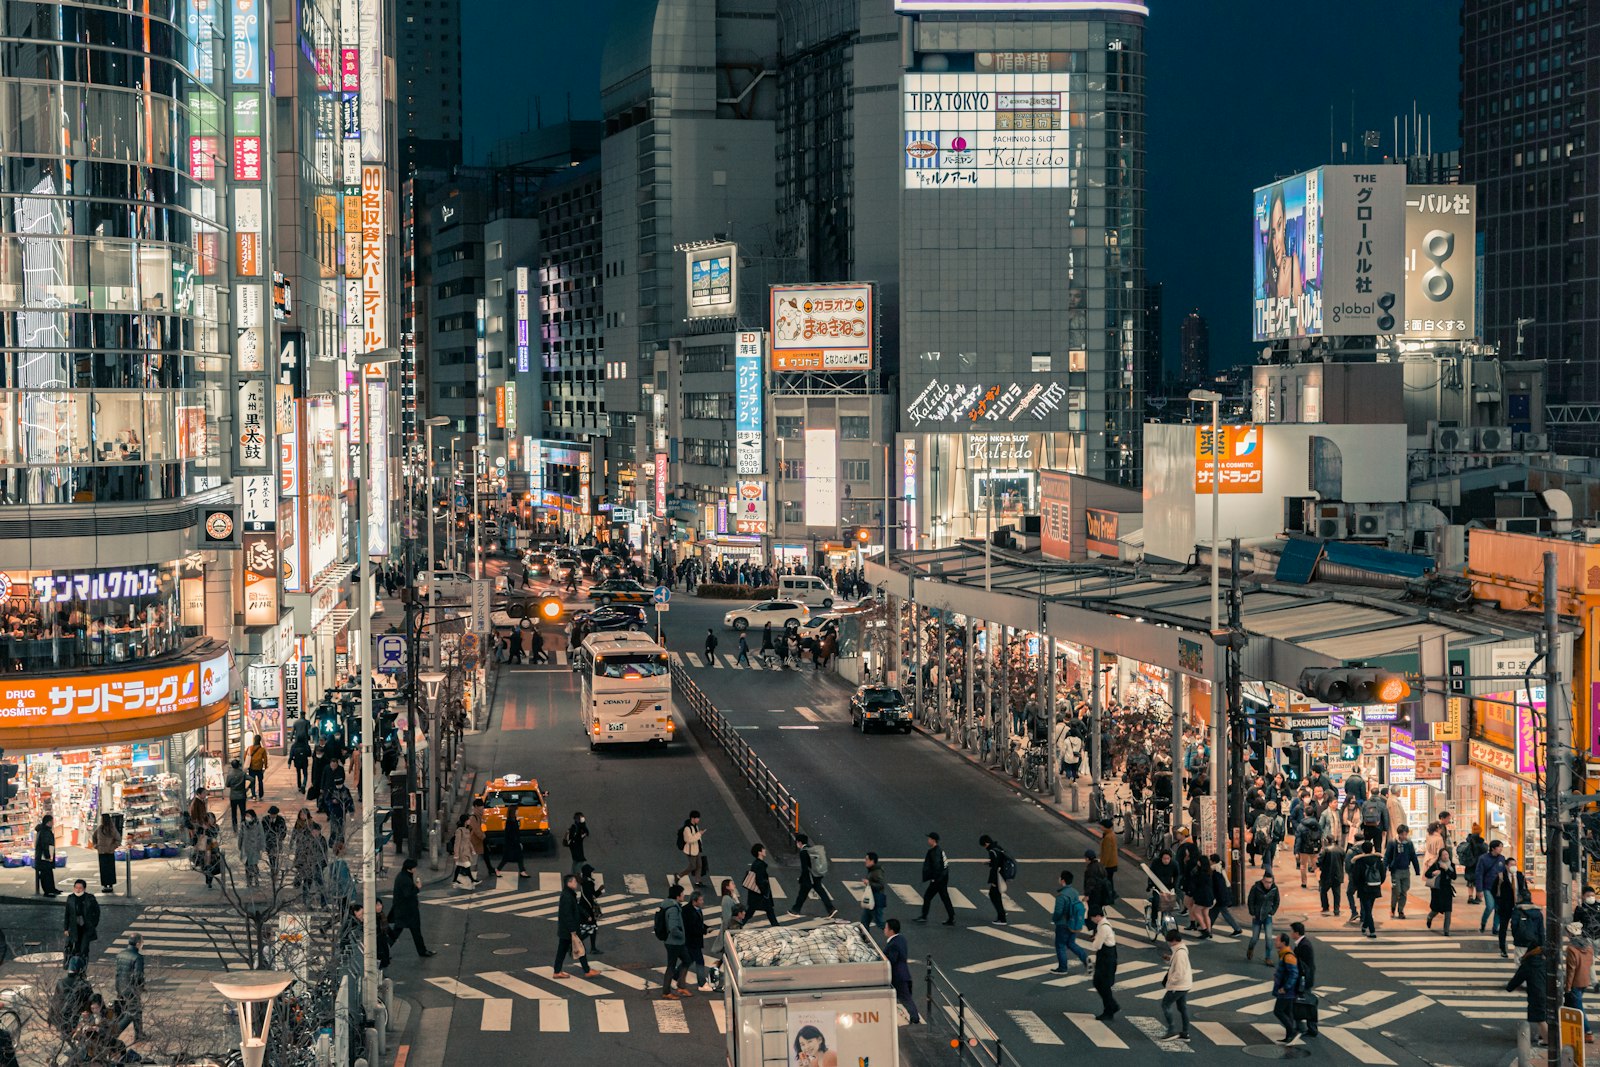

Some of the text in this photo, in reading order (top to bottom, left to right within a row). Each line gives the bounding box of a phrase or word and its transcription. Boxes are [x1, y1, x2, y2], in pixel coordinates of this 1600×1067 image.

[946, 93, 989, 111] TOKYO
[243, 139, 258, 179] 美容室
[986, 147, 1064, 167] Kaleido
[931, 171, 978, 184] ルノアール
[1353, 174, 1377, 183] THE
[1356, 187, 1373, 293] グローバル社
[814, 299, 854, 311] カラオケ
[1333, 302, 1374, 322] global
[741, 334, 756, 342] ED
[803, 318, 866, 340] まねきねこ
[740, 345, 757, 354] 薄毛
[740, 366, 749, 421] クリニック
[749, 361, 758, 427] ユナイテッド
[910, 383, 950, 426] Kaleido
[245, 393, 262, 459] 九州黒太鼓
[968, 444, 1032, 459] Kaleido
[1201, 431, 1225, 455] 薬
[749, 522, 764, 532] すぐ
[1042, 500, 1069, 543] 大黒屋
[6, 690, 36, 699] DRUG
[17, 699, 24, 707] &
[49, 676, 178, 716] サンドラッグ
[1364, 738, 1374, 749] 5
[1416, 762, 1426, 773] 5
[836, 1011, 879, 1024] KRIN
